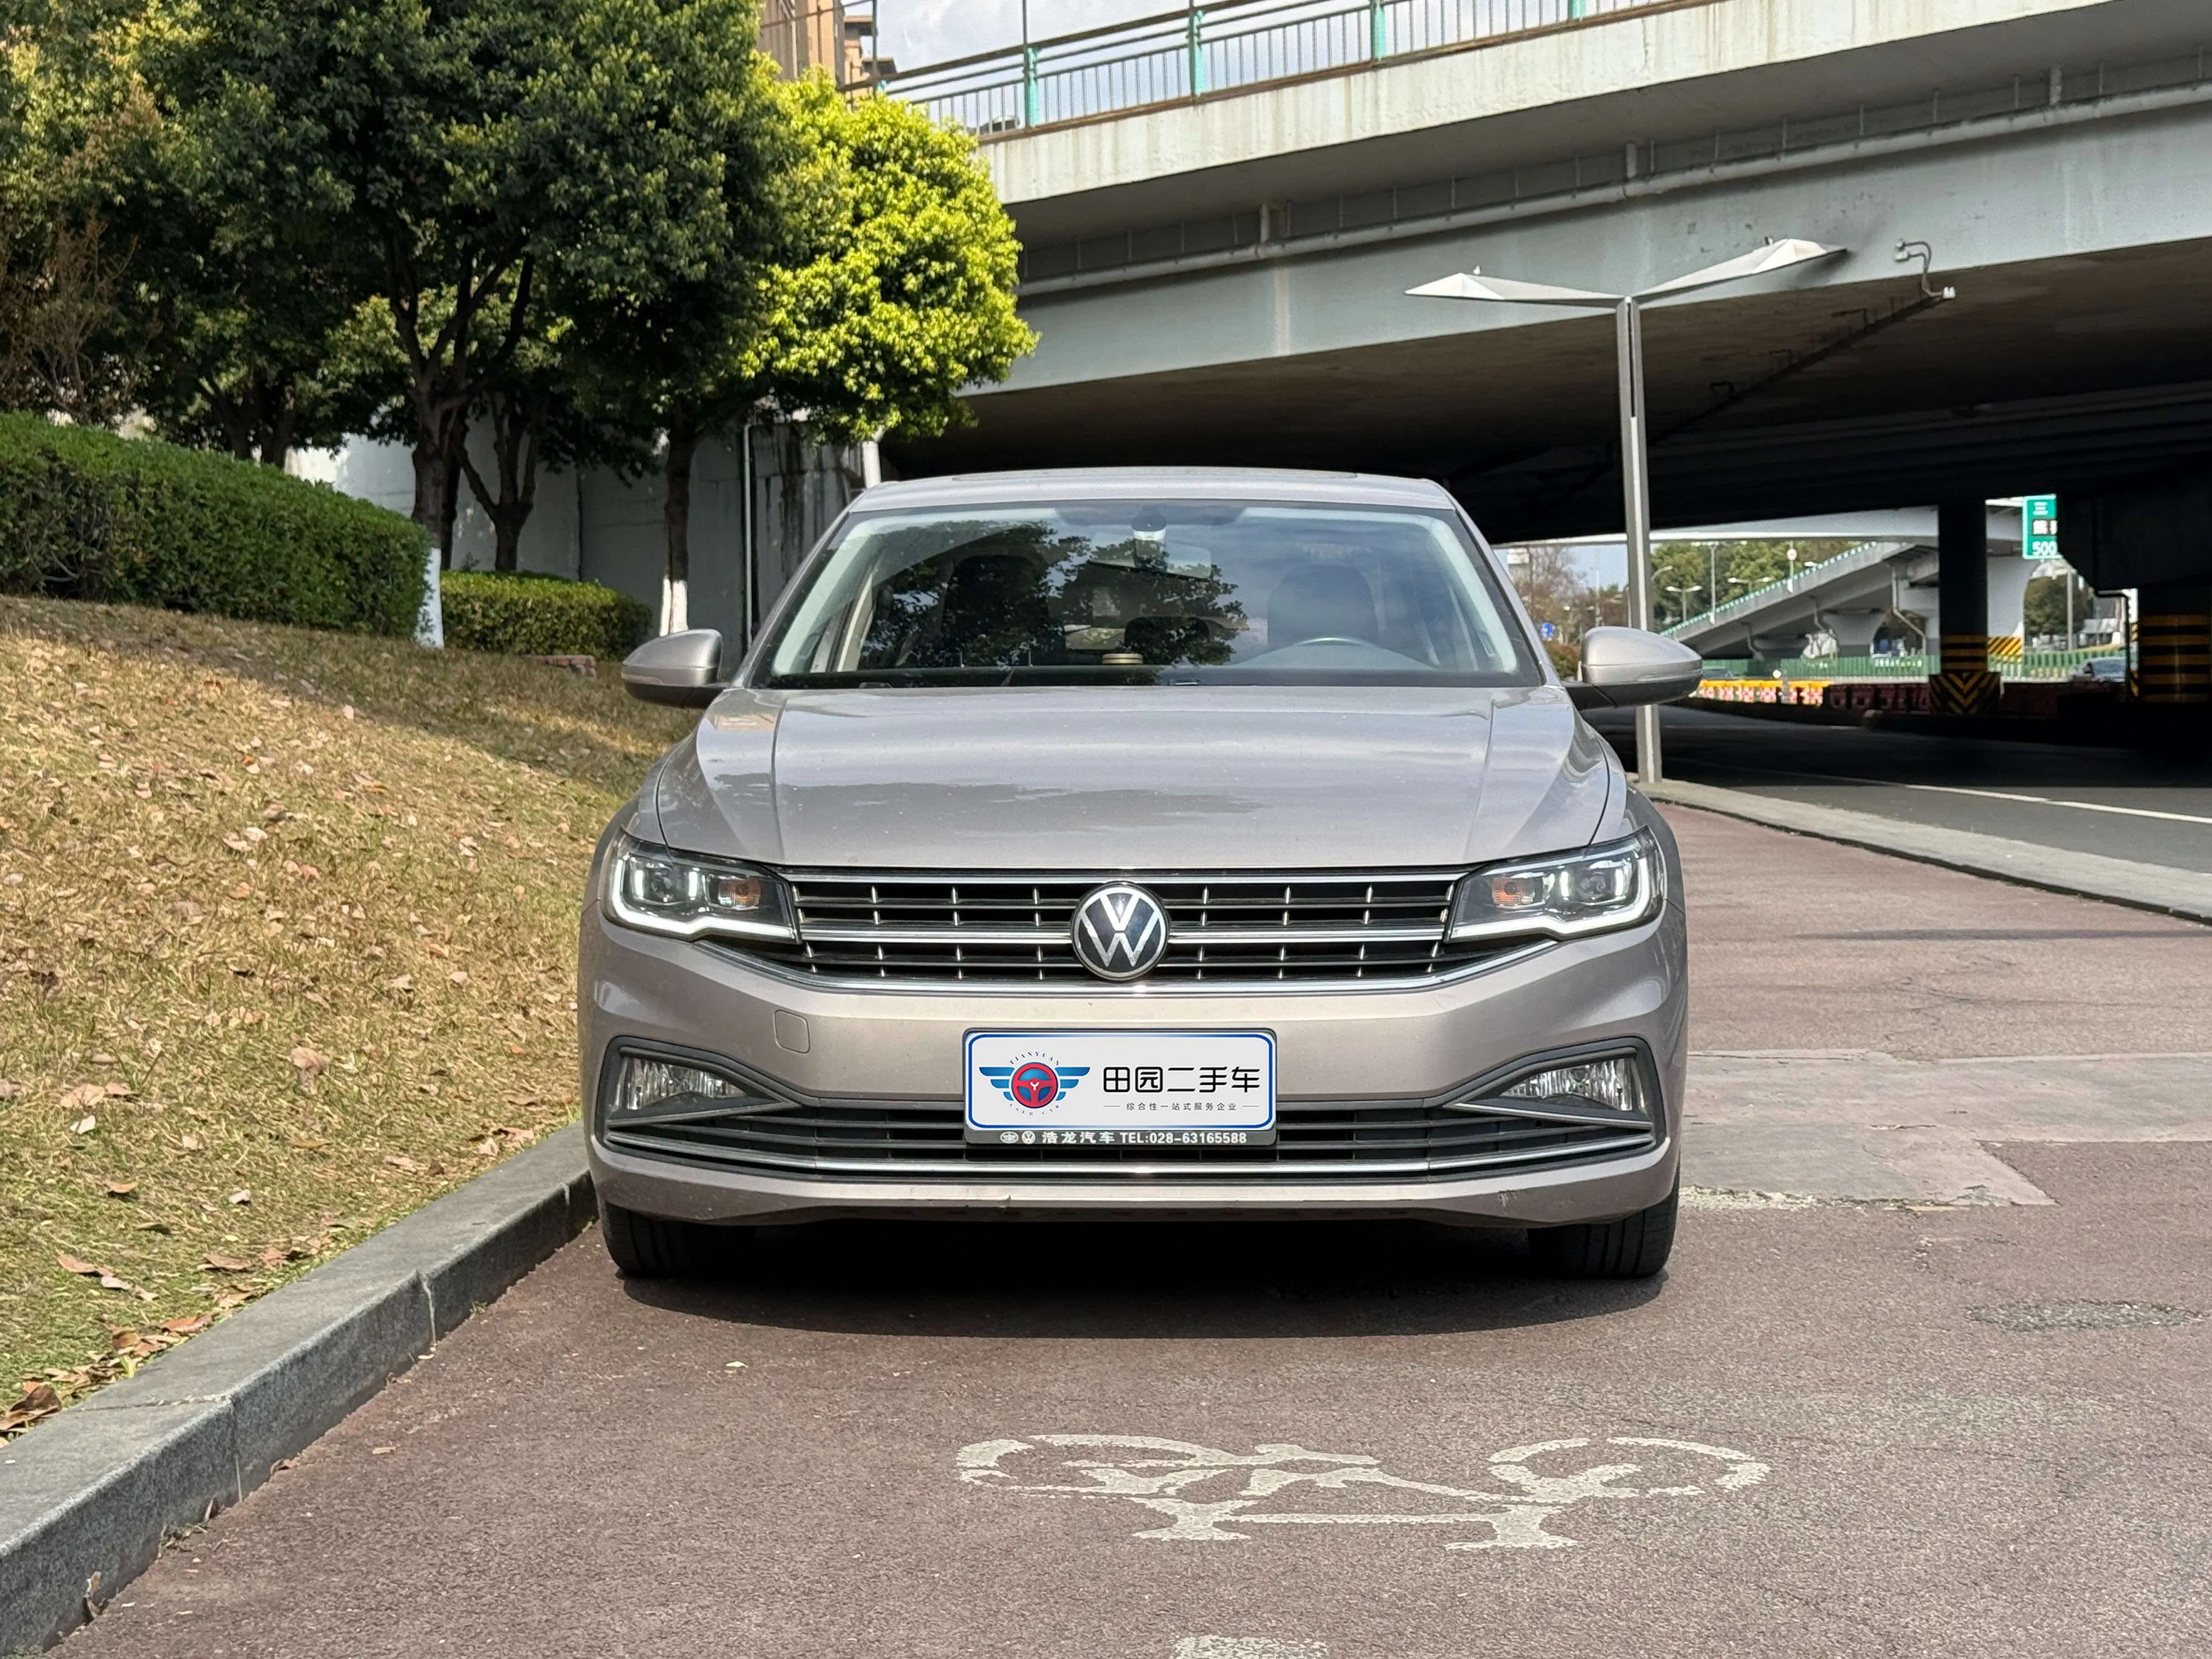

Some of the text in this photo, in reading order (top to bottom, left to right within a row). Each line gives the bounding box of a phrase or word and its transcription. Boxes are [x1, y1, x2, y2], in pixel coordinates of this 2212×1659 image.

[1104, 1066, 1260, 1092] 田园二手车
[1126, 1102, 1236, 1111] 综合性一站式服务企业
[1042, 1131, 1247, 1144] 浩龙汽车 TEL:028-63165588
